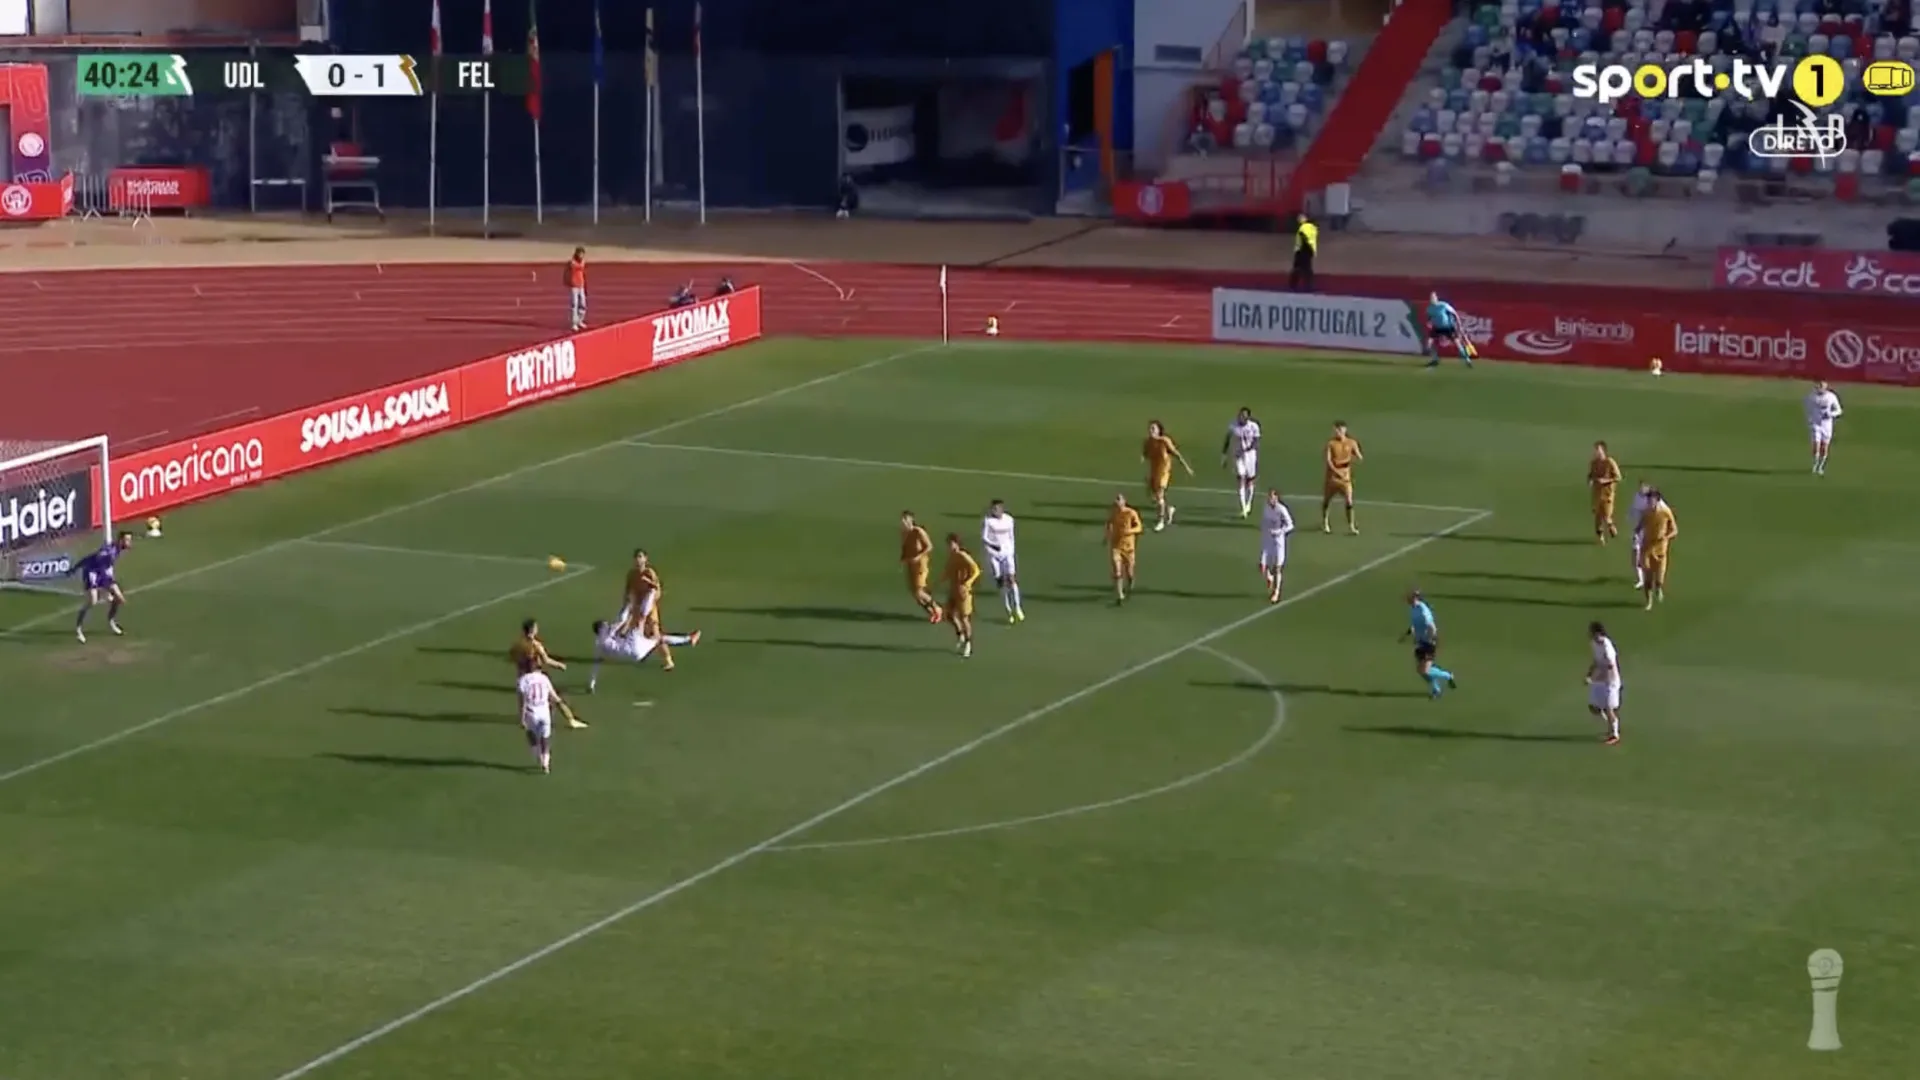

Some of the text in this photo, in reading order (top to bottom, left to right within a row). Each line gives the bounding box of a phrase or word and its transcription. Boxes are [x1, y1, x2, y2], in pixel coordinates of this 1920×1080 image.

[1763, 261, 1820, 288] cdt
[652, 298, 729, 346] ZIYOMAX
[1221, 302, 1386, 338] LIGA PORTUGAL 2
[1675, 322, 1806, 360] leirisonda
[119, 438, 263, 503] americana
[0, 488, 76, 543] Haier
